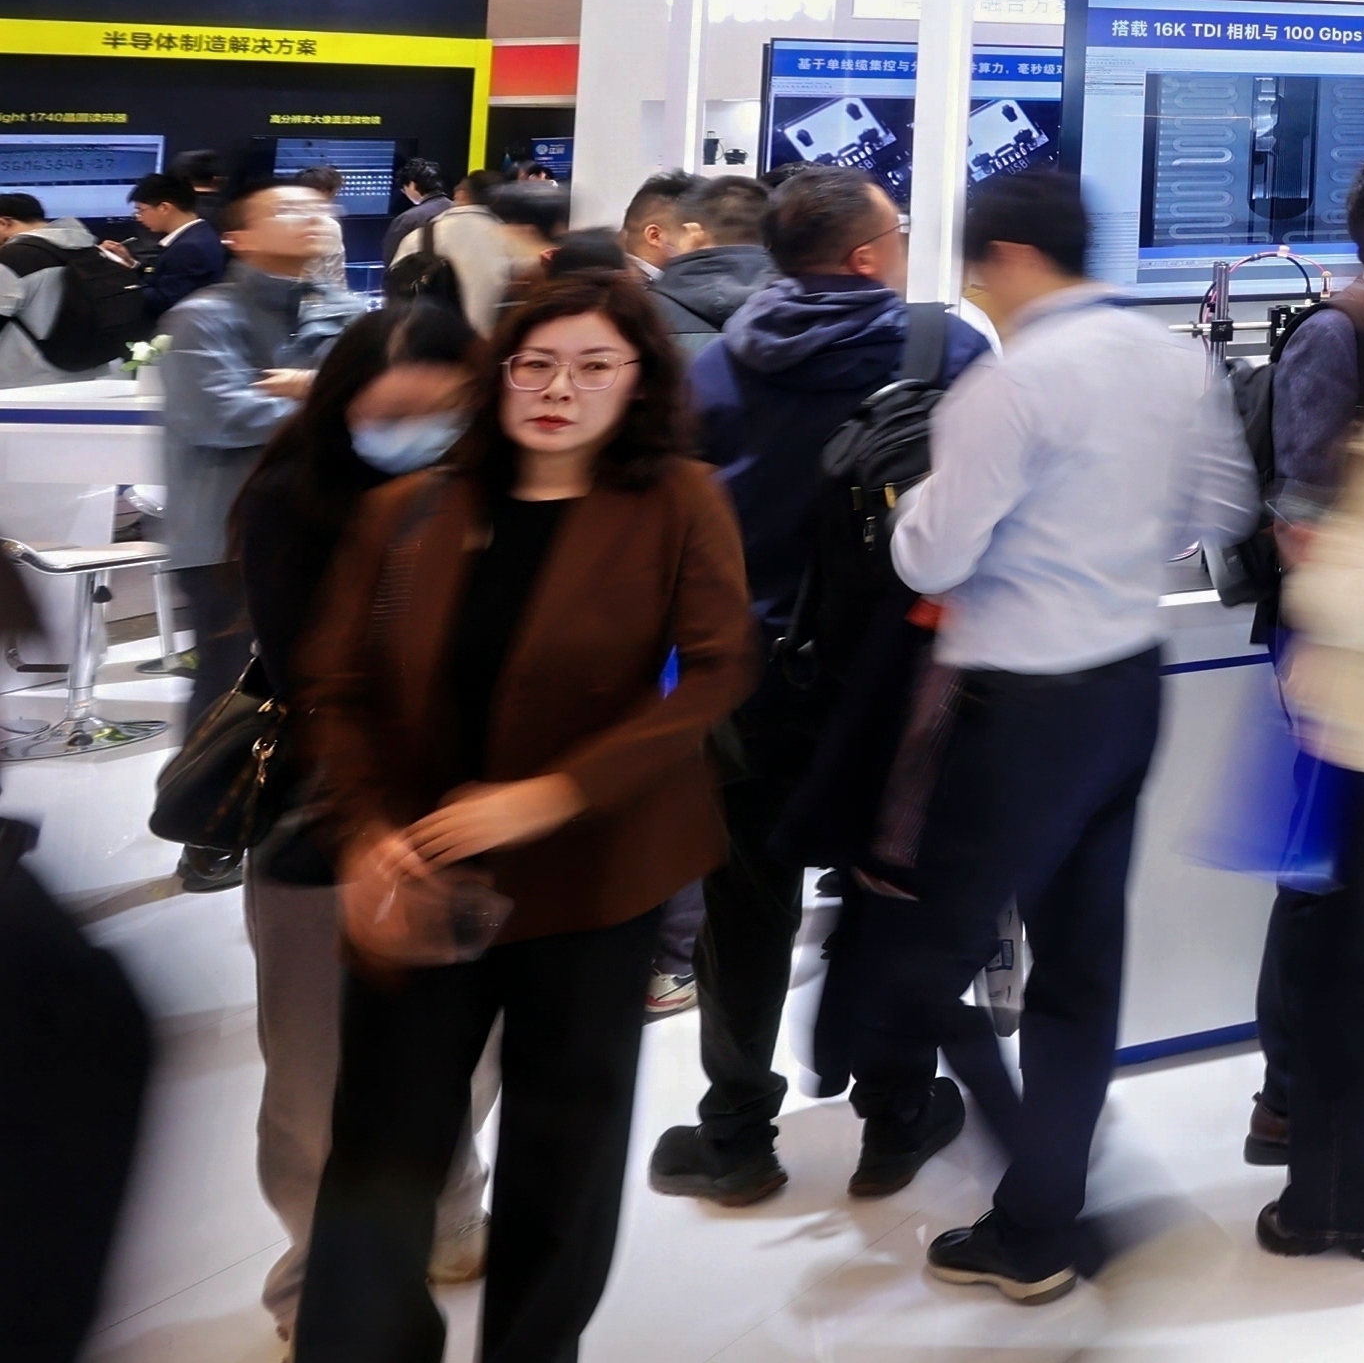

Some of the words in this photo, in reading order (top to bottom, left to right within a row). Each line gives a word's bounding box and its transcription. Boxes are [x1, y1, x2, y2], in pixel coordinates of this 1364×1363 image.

[1111, 18, 1148, 39] 搭载
[1153, 22, 1187, 38] 16K
[1192, 23, 1222, 39] TDI
[1226, 23, 1278, 41] 相机与
[1283, 25, 1315, 41] 100
[102, 31, 318, 56] 半导体制造解决方案
